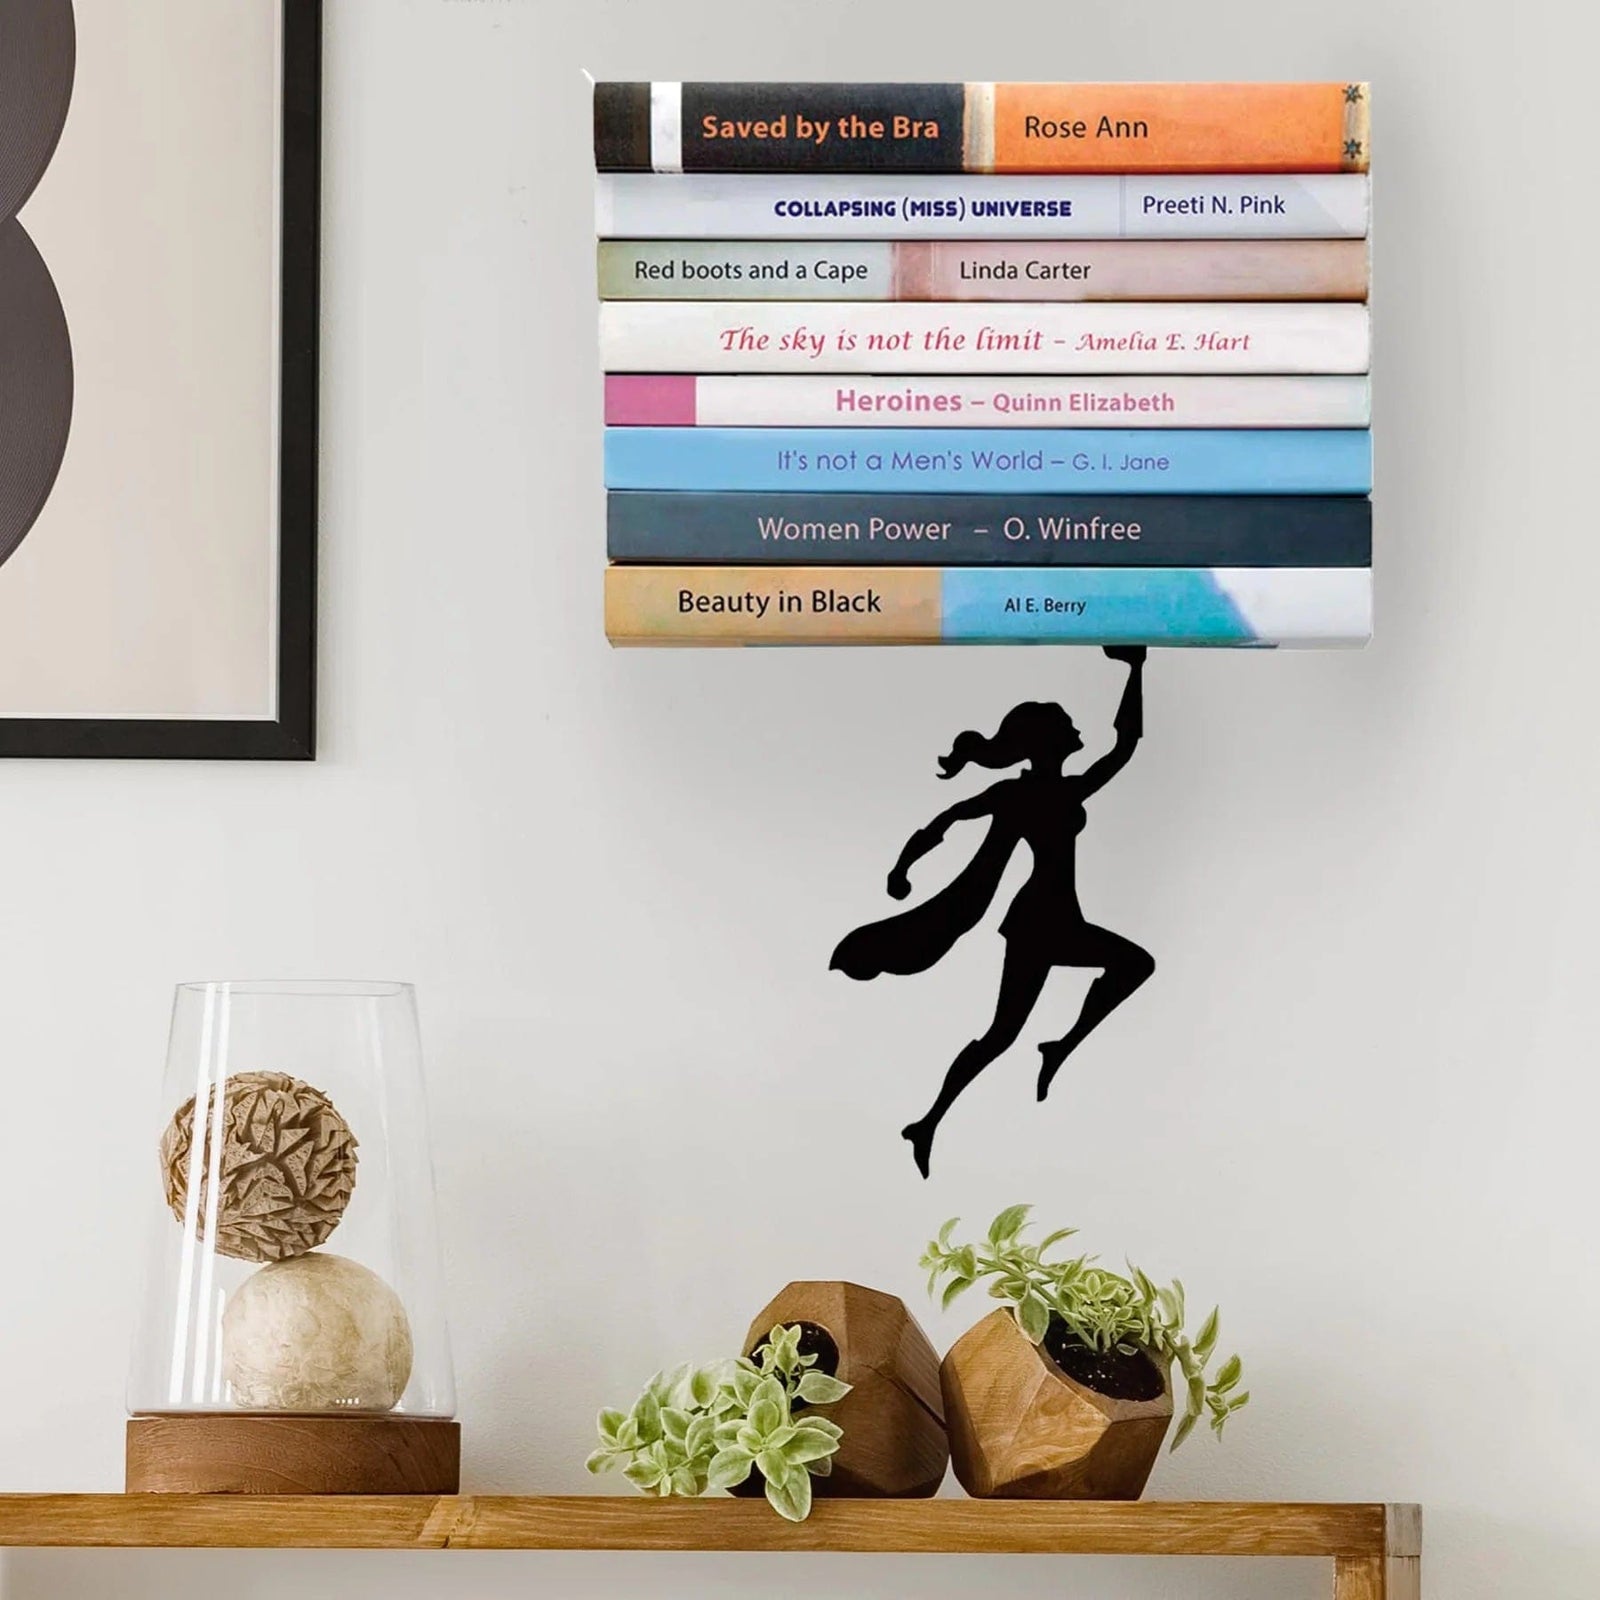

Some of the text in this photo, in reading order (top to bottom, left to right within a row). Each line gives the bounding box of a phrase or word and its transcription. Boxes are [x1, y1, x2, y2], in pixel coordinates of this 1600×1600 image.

[702, 114, 939, 145] Saved by the Bra
[1025, 115, 1148, 139] Rose Ann
[774, 196, 1072, 222] COLLAPSING (MISS) UNIVERSE
[1143, 194, 1286, 215] Preeti N. Pink
[634, 259, 868, 284] Red boots and a Cape
[960, 260, 1091, 280] Linda Carter
[719, 326, 770, 351] The
[778, 326, 826, 359] sky
[837, 329, 857, 351] is
[868, 330, 913, 351] not
[924, 326, 966, 351] the
[976, 326, 1043, 351] limit
[1075, 330, 1157, 351] Amelia
[1165, 333, 1186, 351] E.
[1193, 332, 1249, 351] Hart
[836, 388, 963, 412] Heroines
[992, 393, 1062, 414] Quinn
[1069, 392, 1175, 412] Elizabeth
[778, 450, 808, 471] It's
[816, 450, 857, 471] not
[865, 454, 882, 471] a
[891, 450, 963, 471] Men's
[971, 449, 1043, 471] World
[1072, 452, 1095, 471] G.
[1102, 454, 1113, 471] I.
[1120, 454, 1170, 471] Jane
[757, 517, 860, 541] Women
[869, 517, 952, 541] Power
[1003, 517, 1030, 540] O.
[1038, 516, 1141, 540] Winfree
[678, 588, 882, 619] Beauty in Black
[1004, 597, 1087, 616] Al E. Berry
